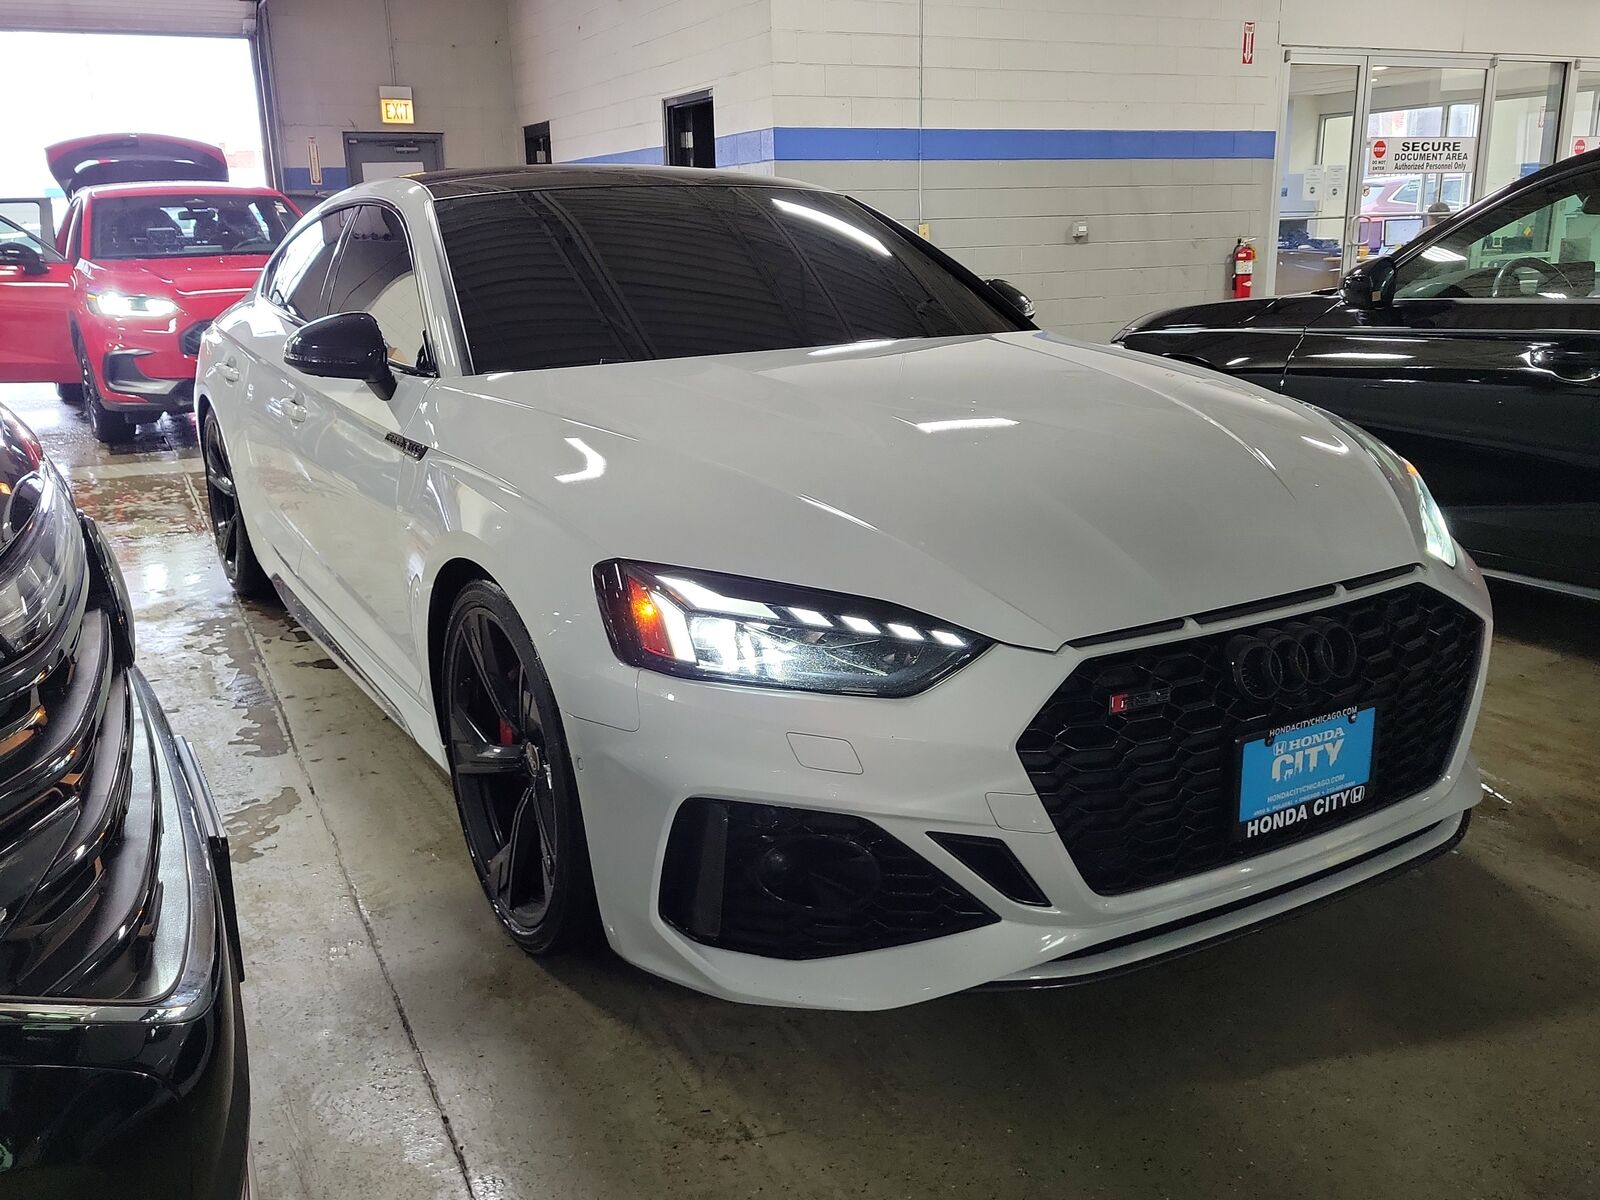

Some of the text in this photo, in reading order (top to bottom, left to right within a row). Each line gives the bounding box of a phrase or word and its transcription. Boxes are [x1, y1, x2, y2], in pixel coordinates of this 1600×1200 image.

[385, 102, 409, 120] EXIT
[1394, 152, 1468, 161] DOCUMENT AREA
[1401, 141, 1461, 152] SECURE
[1394, 161, 1467, 171] Authorized Personnel Only
[1269, 705, 1358, 738] HONDACITYCHICAGO.COM
[1289, 726, 1346, 750] HONDA
[1271, 738, 1345, 783] CITY
[1246, 804, 1308, 839] HONDA
[1313, 789, 1351, 817] CITY
